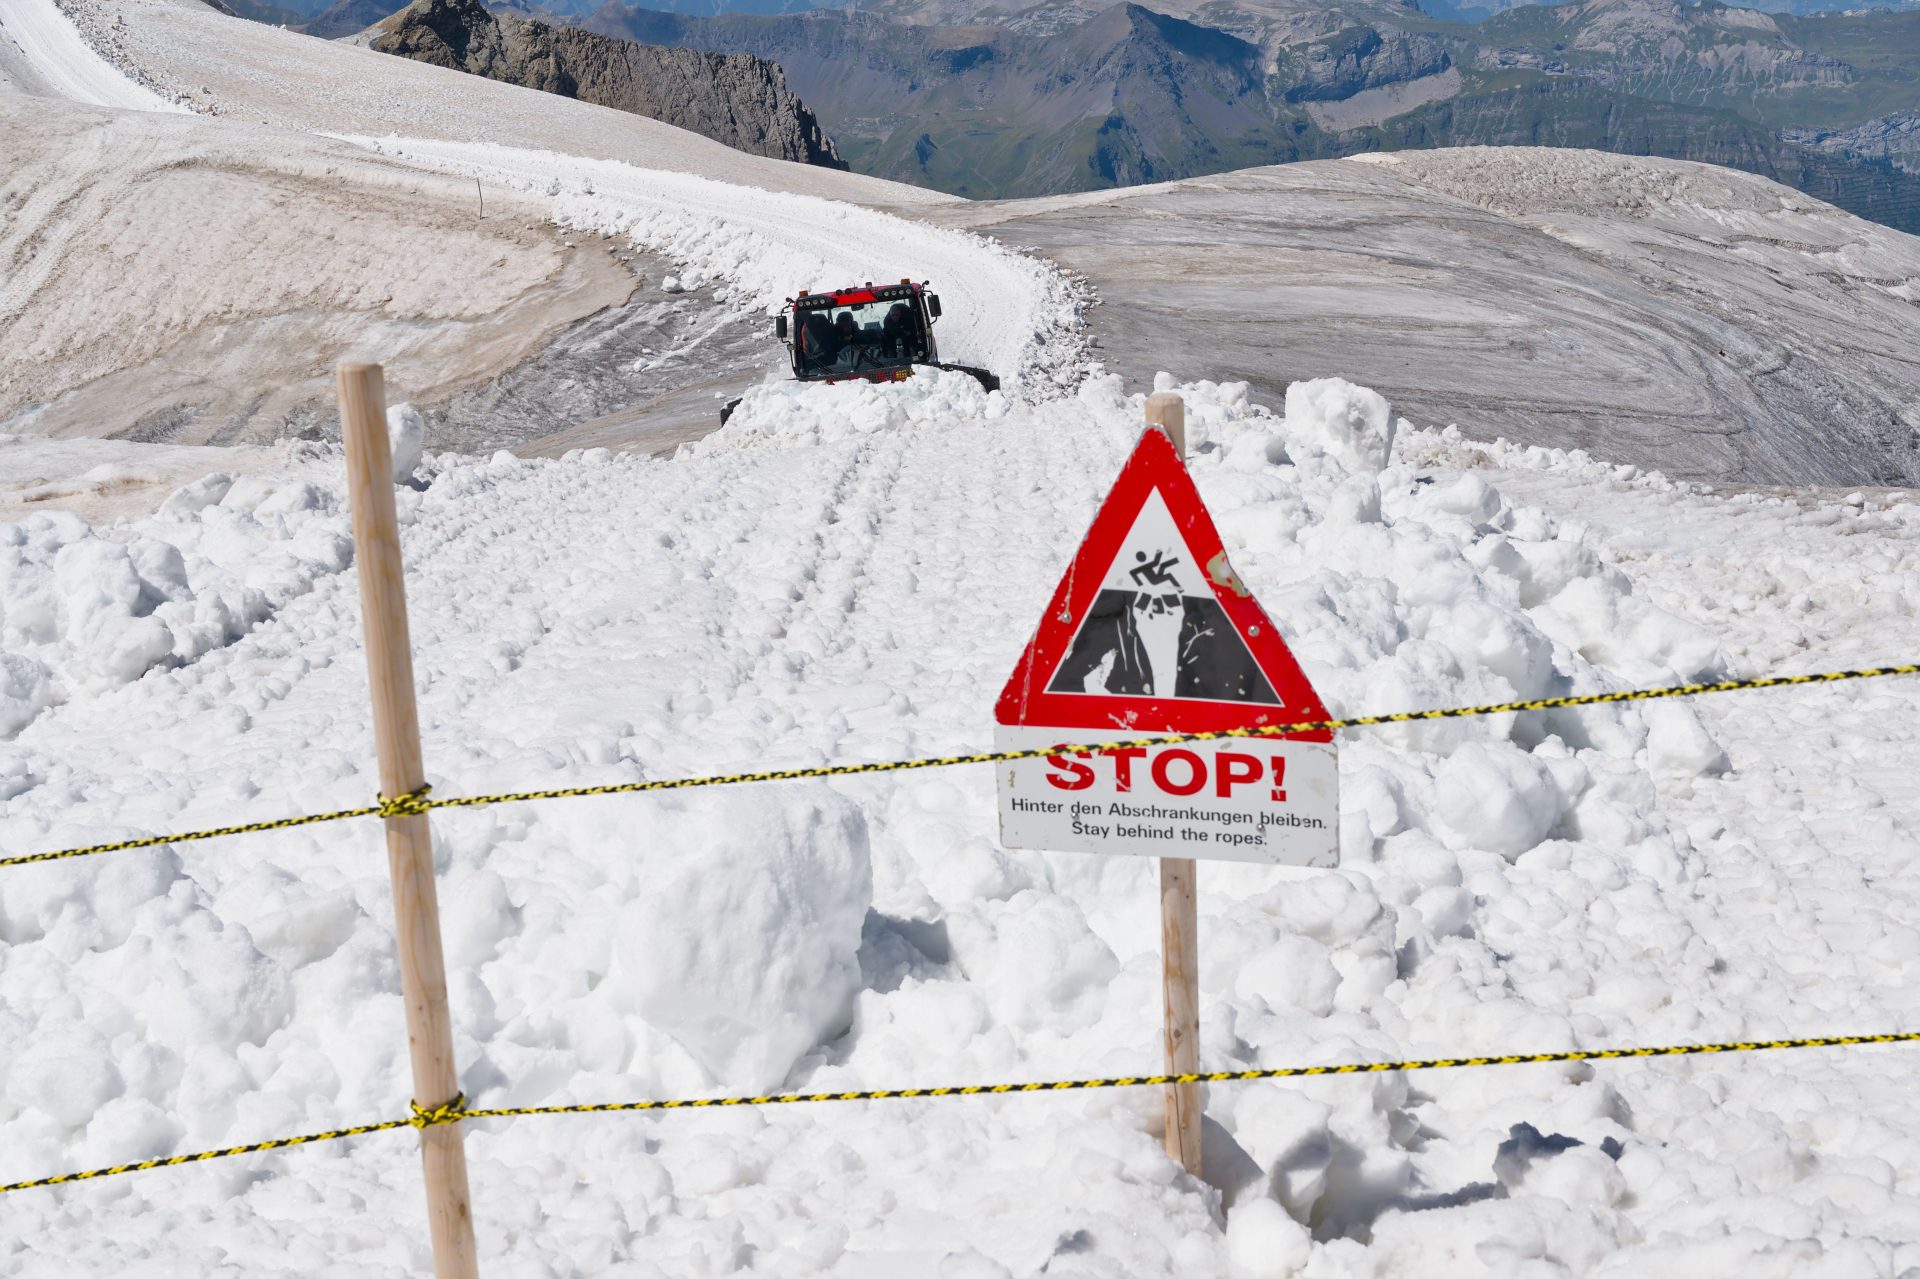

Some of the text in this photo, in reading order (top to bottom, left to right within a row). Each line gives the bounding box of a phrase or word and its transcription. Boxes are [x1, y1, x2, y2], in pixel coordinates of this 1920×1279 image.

[1045, 743, 1287, 802] STOP!
[1011, 797, 1327, 829] Hinter den Abschrankungen bleiben.
[1072, 821, 1268, 847] Stay behind the ropes.
